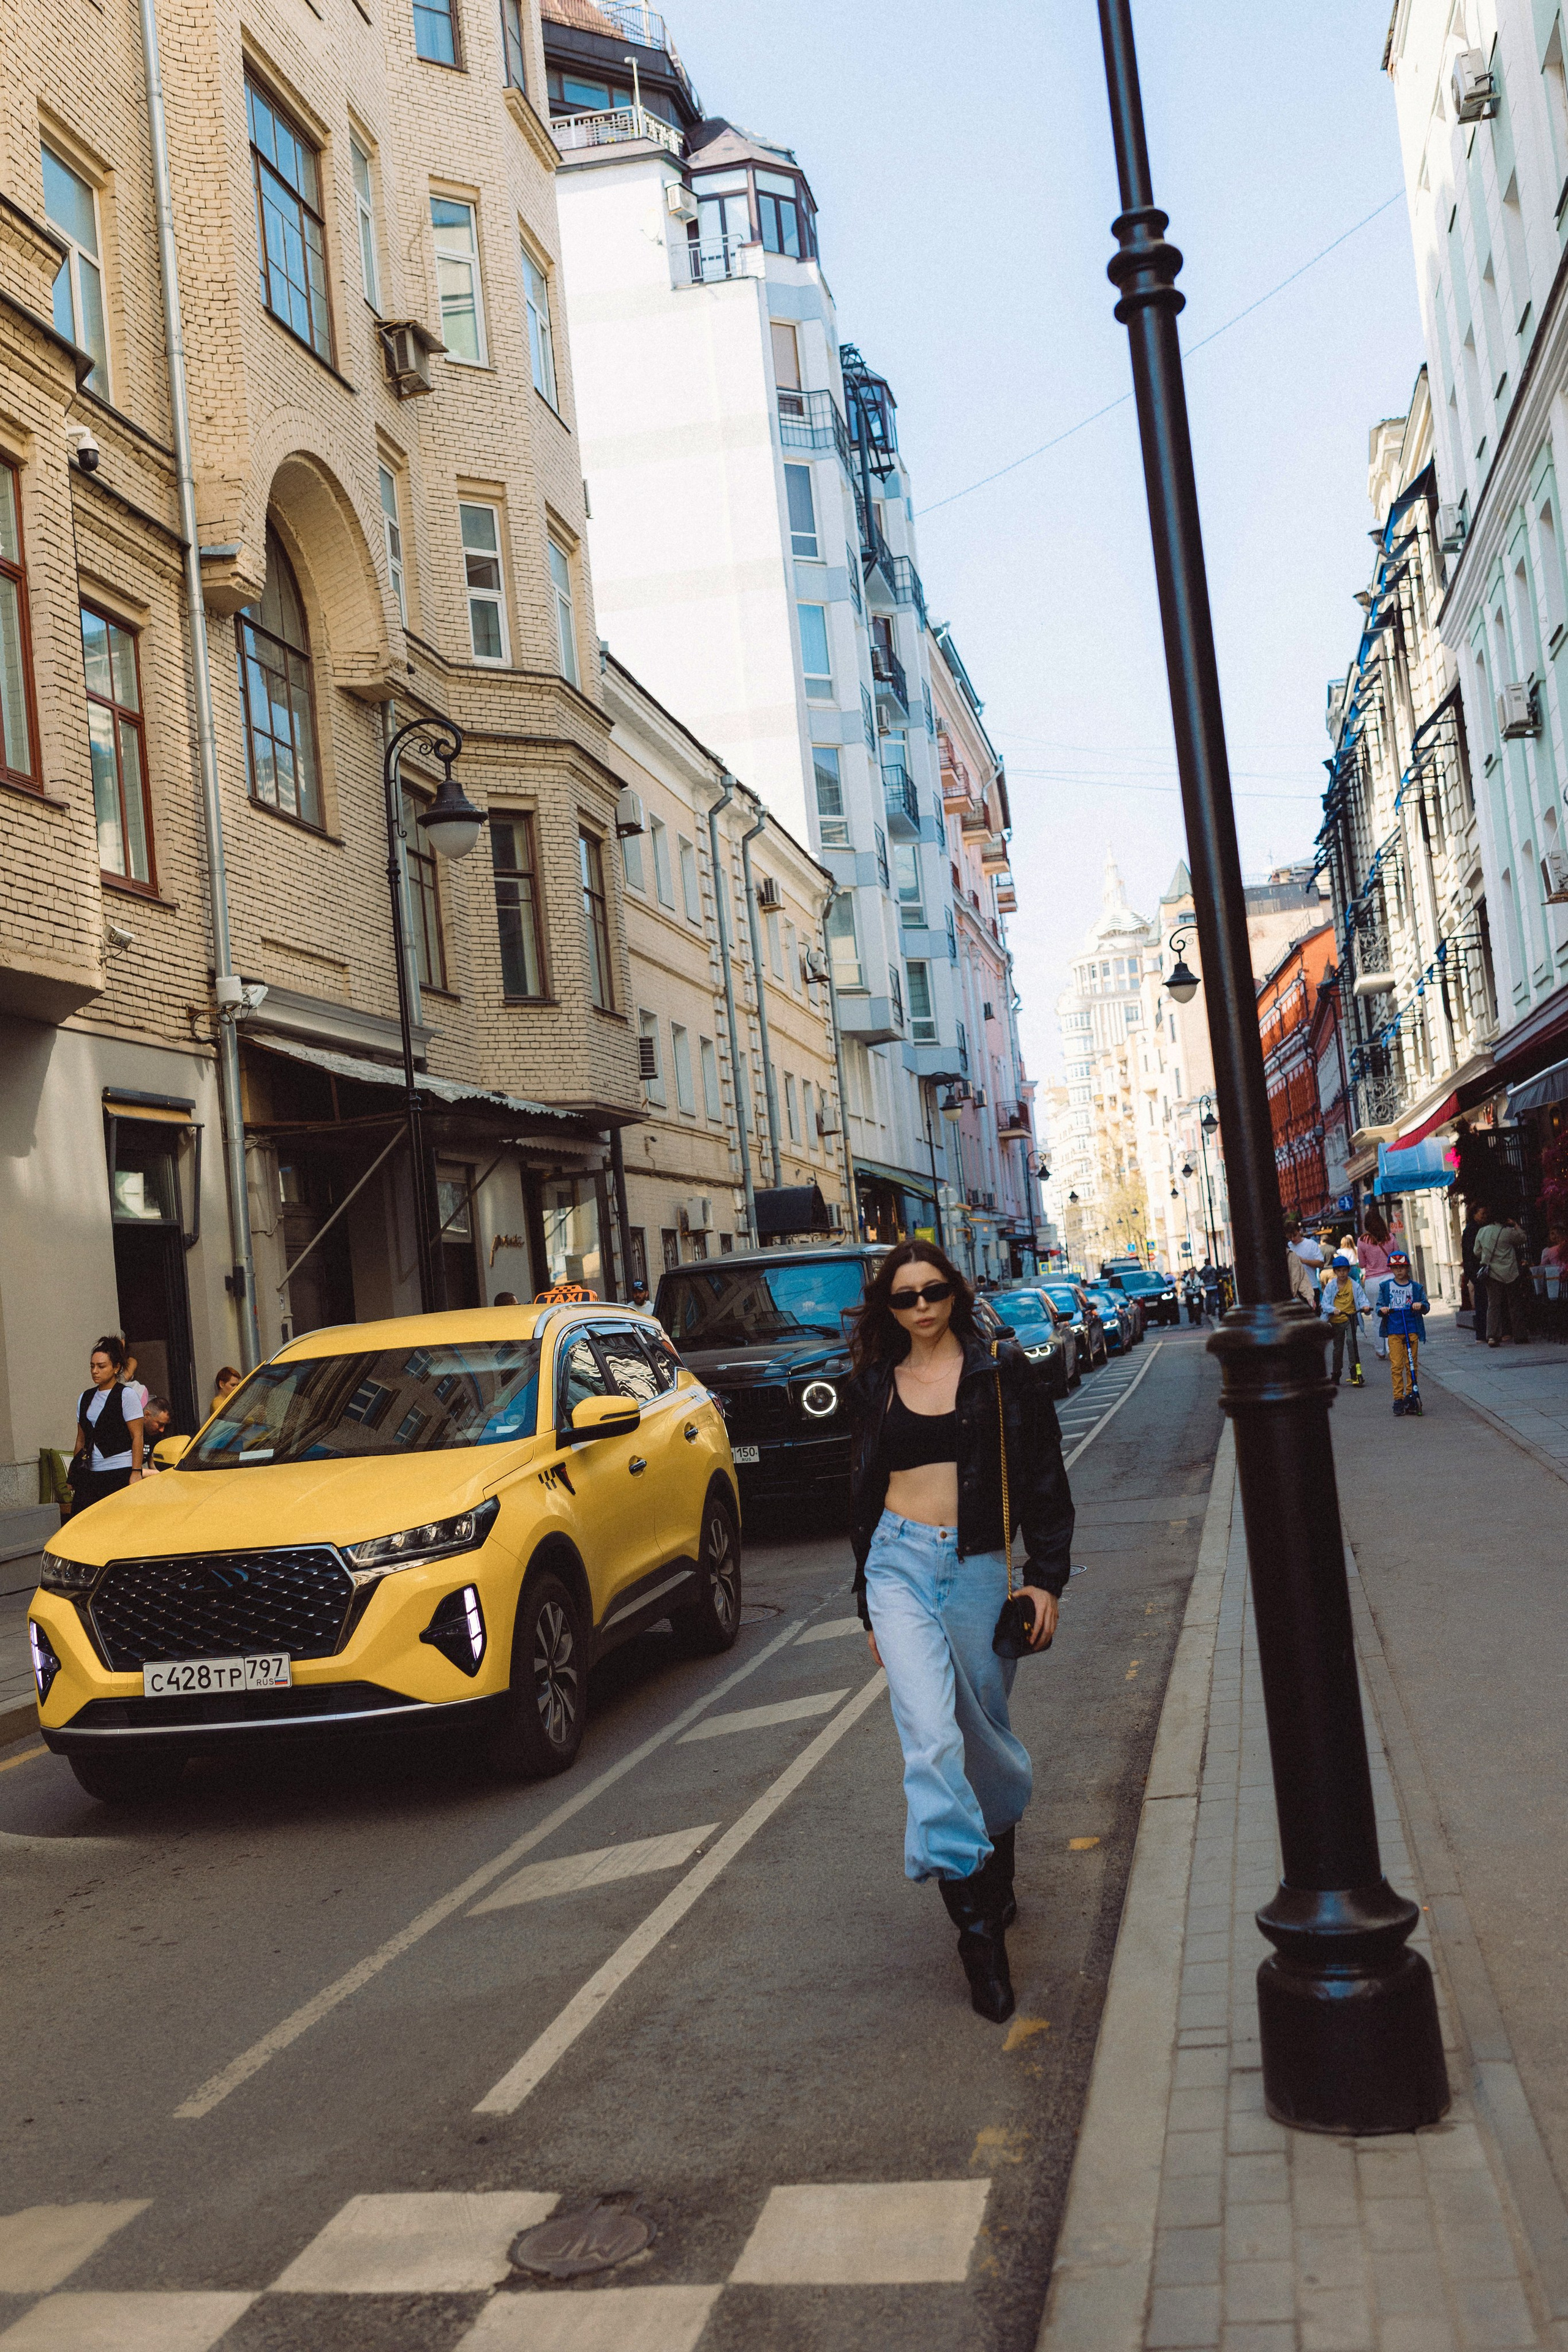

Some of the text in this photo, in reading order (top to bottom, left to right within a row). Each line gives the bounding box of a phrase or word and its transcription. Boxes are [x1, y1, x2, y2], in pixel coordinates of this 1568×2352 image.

[544, 1293, 583, 1304] TAXI
[736, 1447, 755, 1458] 150
[246, 1657, 283, 1679] 797
[256, 1678, 274, 1686] RUS
